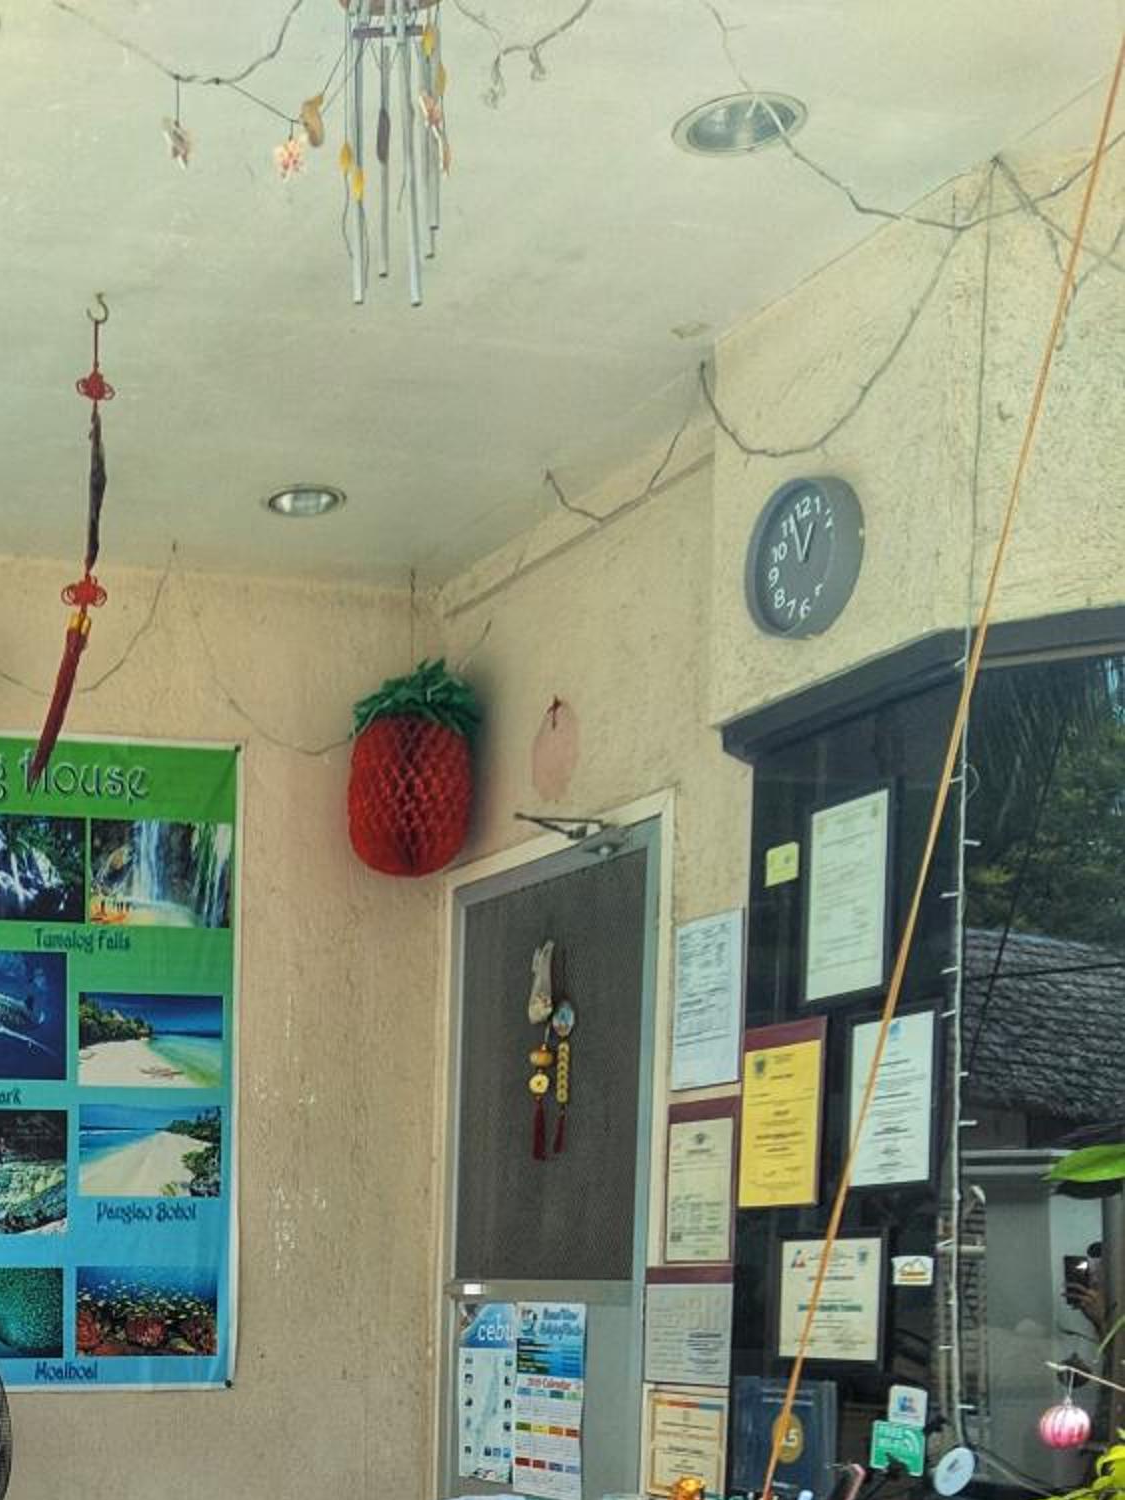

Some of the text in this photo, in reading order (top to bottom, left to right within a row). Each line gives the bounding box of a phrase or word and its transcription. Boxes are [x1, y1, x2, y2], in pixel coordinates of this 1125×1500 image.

[795, 496, 812, 520] 12
[772, 541, 788, 563] 10
[768, 566, 780, 590] 9
[774, 588, 786, 609] 8
[786, 597, 796, 620] 7
[799, 598, 811, 619] 6
[36, 927, 131, 954] Tumalog Falls
[96, 1201, 197, 1224] Panglao Bohol
[34, 1361, 99, 1380] Moalboal
